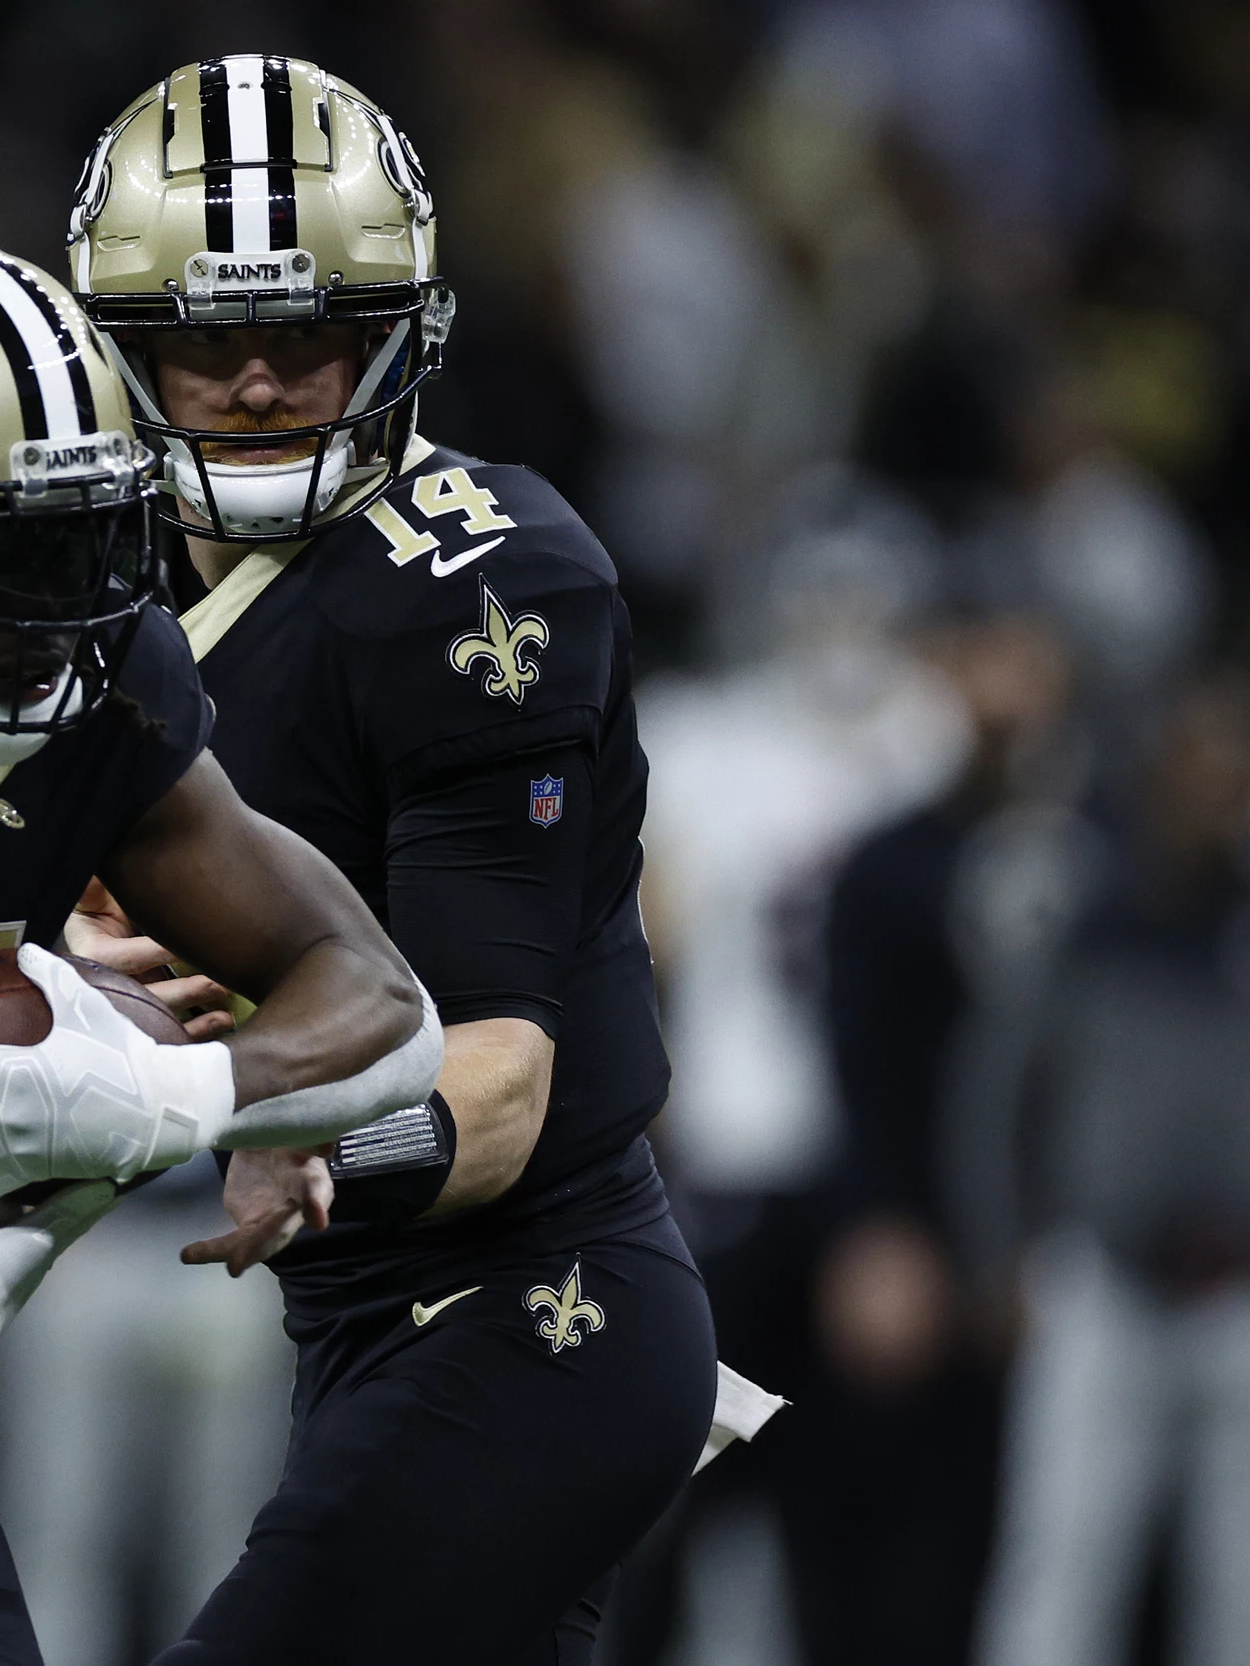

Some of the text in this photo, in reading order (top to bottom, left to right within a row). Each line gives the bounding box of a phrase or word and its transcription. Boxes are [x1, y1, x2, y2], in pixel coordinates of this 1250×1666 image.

[218, 264, 281, 279] SAINTS
[364, 467, 518, 567] 14
[534, 797, 559, 820] NFL
